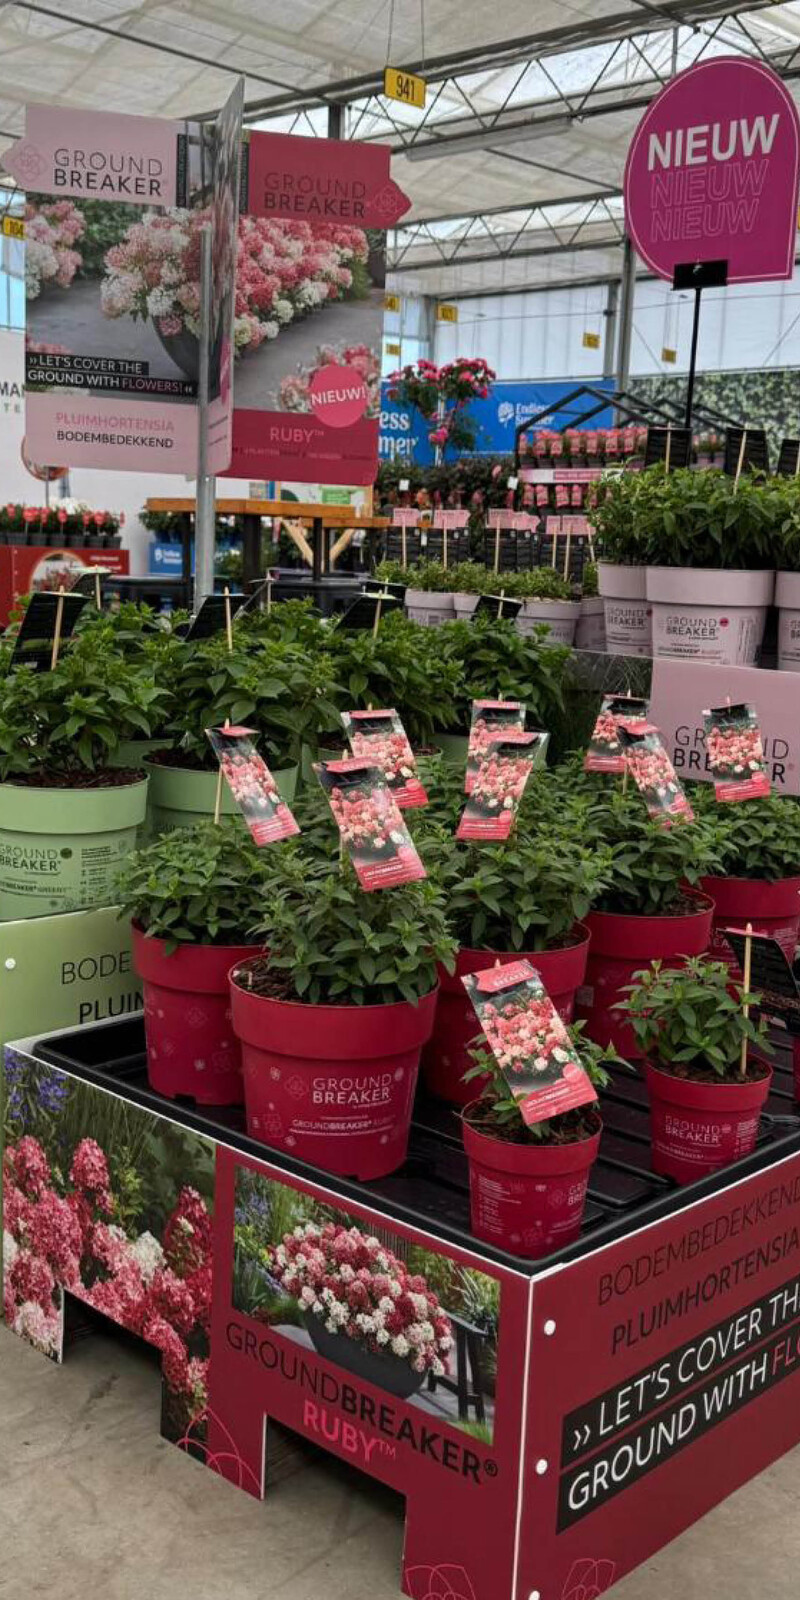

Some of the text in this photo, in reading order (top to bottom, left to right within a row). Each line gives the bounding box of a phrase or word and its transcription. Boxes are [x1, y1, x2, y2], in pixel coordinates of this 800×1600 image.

[396, 74, 415, 102] 941
[647, 113, 780, 171] NIEUW
[54, 148, 163, 177] GROUND
[54, 168, 162, 197] BREAKER
[264, 172, 366, 199] GROUND
[651, 159, 770, 209] NIEUW
[264, 192, 365, 218] BREAKER
[651, 198, 761, 243] NIEUW
[39, 354, 71, 368] LET'S
[73, 358, 116, 372] COVER
[119, 361, 143, 375] THE
[27, 369, 84, 385] GROUND
[86, 374, 120, 388] WITH
[122, 378, 183, 394] FLOWERS!
[311, 386, 367, 406] NIEUW!
[55, 412, 175, 432] PLUIMHORTENSIA
[56, 430, 174, 449] BODEMBEDEKKEND
[666, 616, 717, 628] GROUND
[312, 1073, 392, 1091] GROUND
[610, 1226, 800, 1356] PLUIMHORTENSIA
[599, 1362, 671, 1437] LET'S
[678, 1307, 763, 1384] COVER
[769, 1282, 800, 1327] TH
[225, 1321, 499, 1485] GROUNDBREAKER®
[303, 1399, 397, 1463] RUBY™
[568, 1336, 800, 1511] GROUND WITH FL
